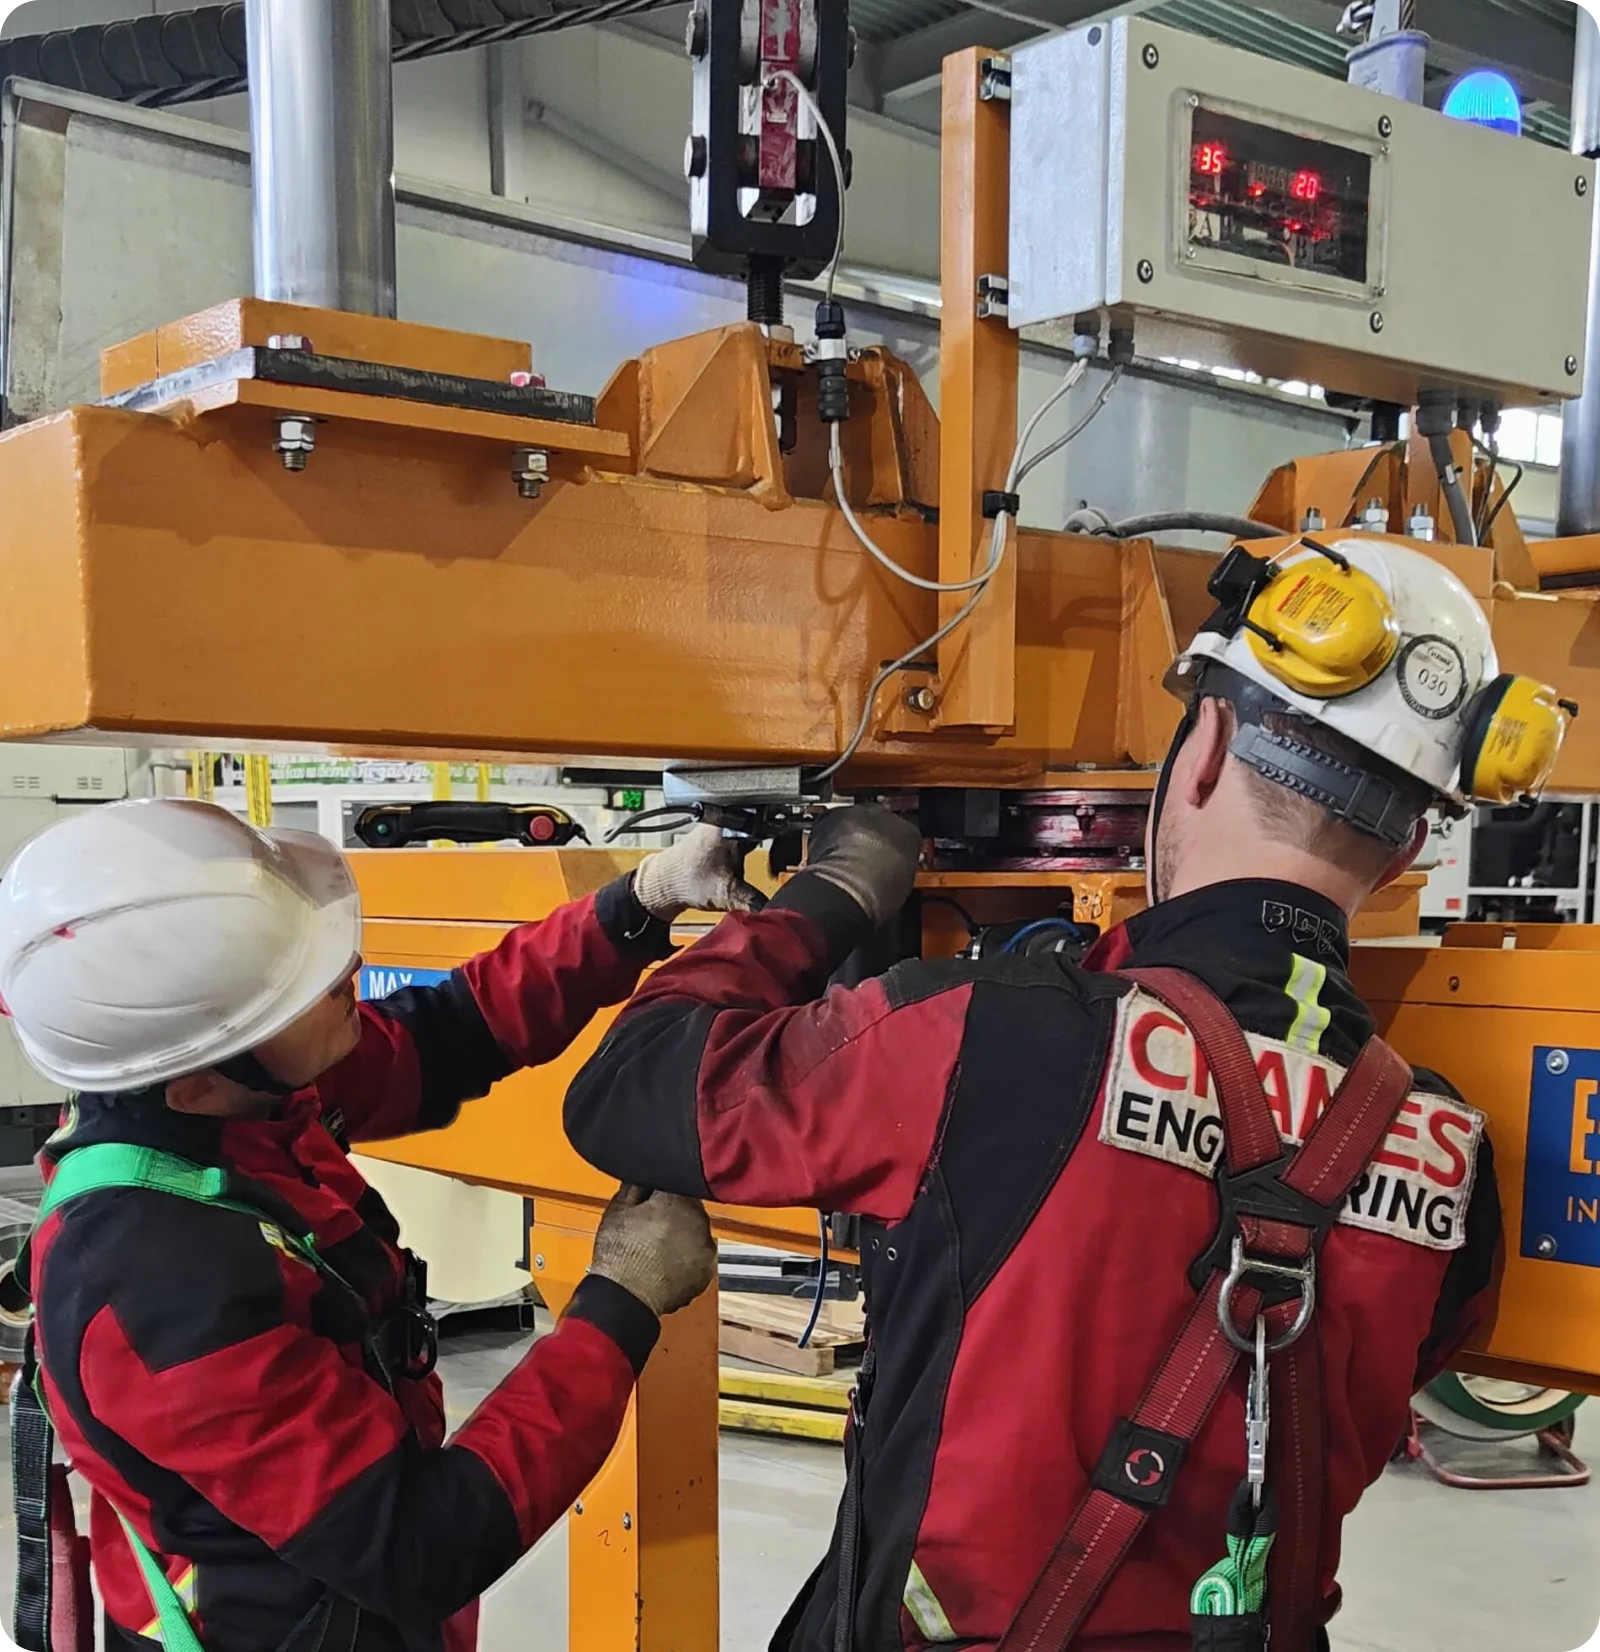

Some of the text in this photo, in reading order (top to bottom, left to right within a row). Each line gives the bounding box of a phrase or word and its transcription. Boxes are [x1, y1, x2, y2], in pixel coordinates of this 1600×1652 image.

[1201, 147, 1223, 173] 35
[1296, 175, 1318, 199] 20
[1418, 668, 1448, 697] 030
[1569, 1079, 1600, 1176] E
[1117, 1090, 1456, 1240] ENGRING
